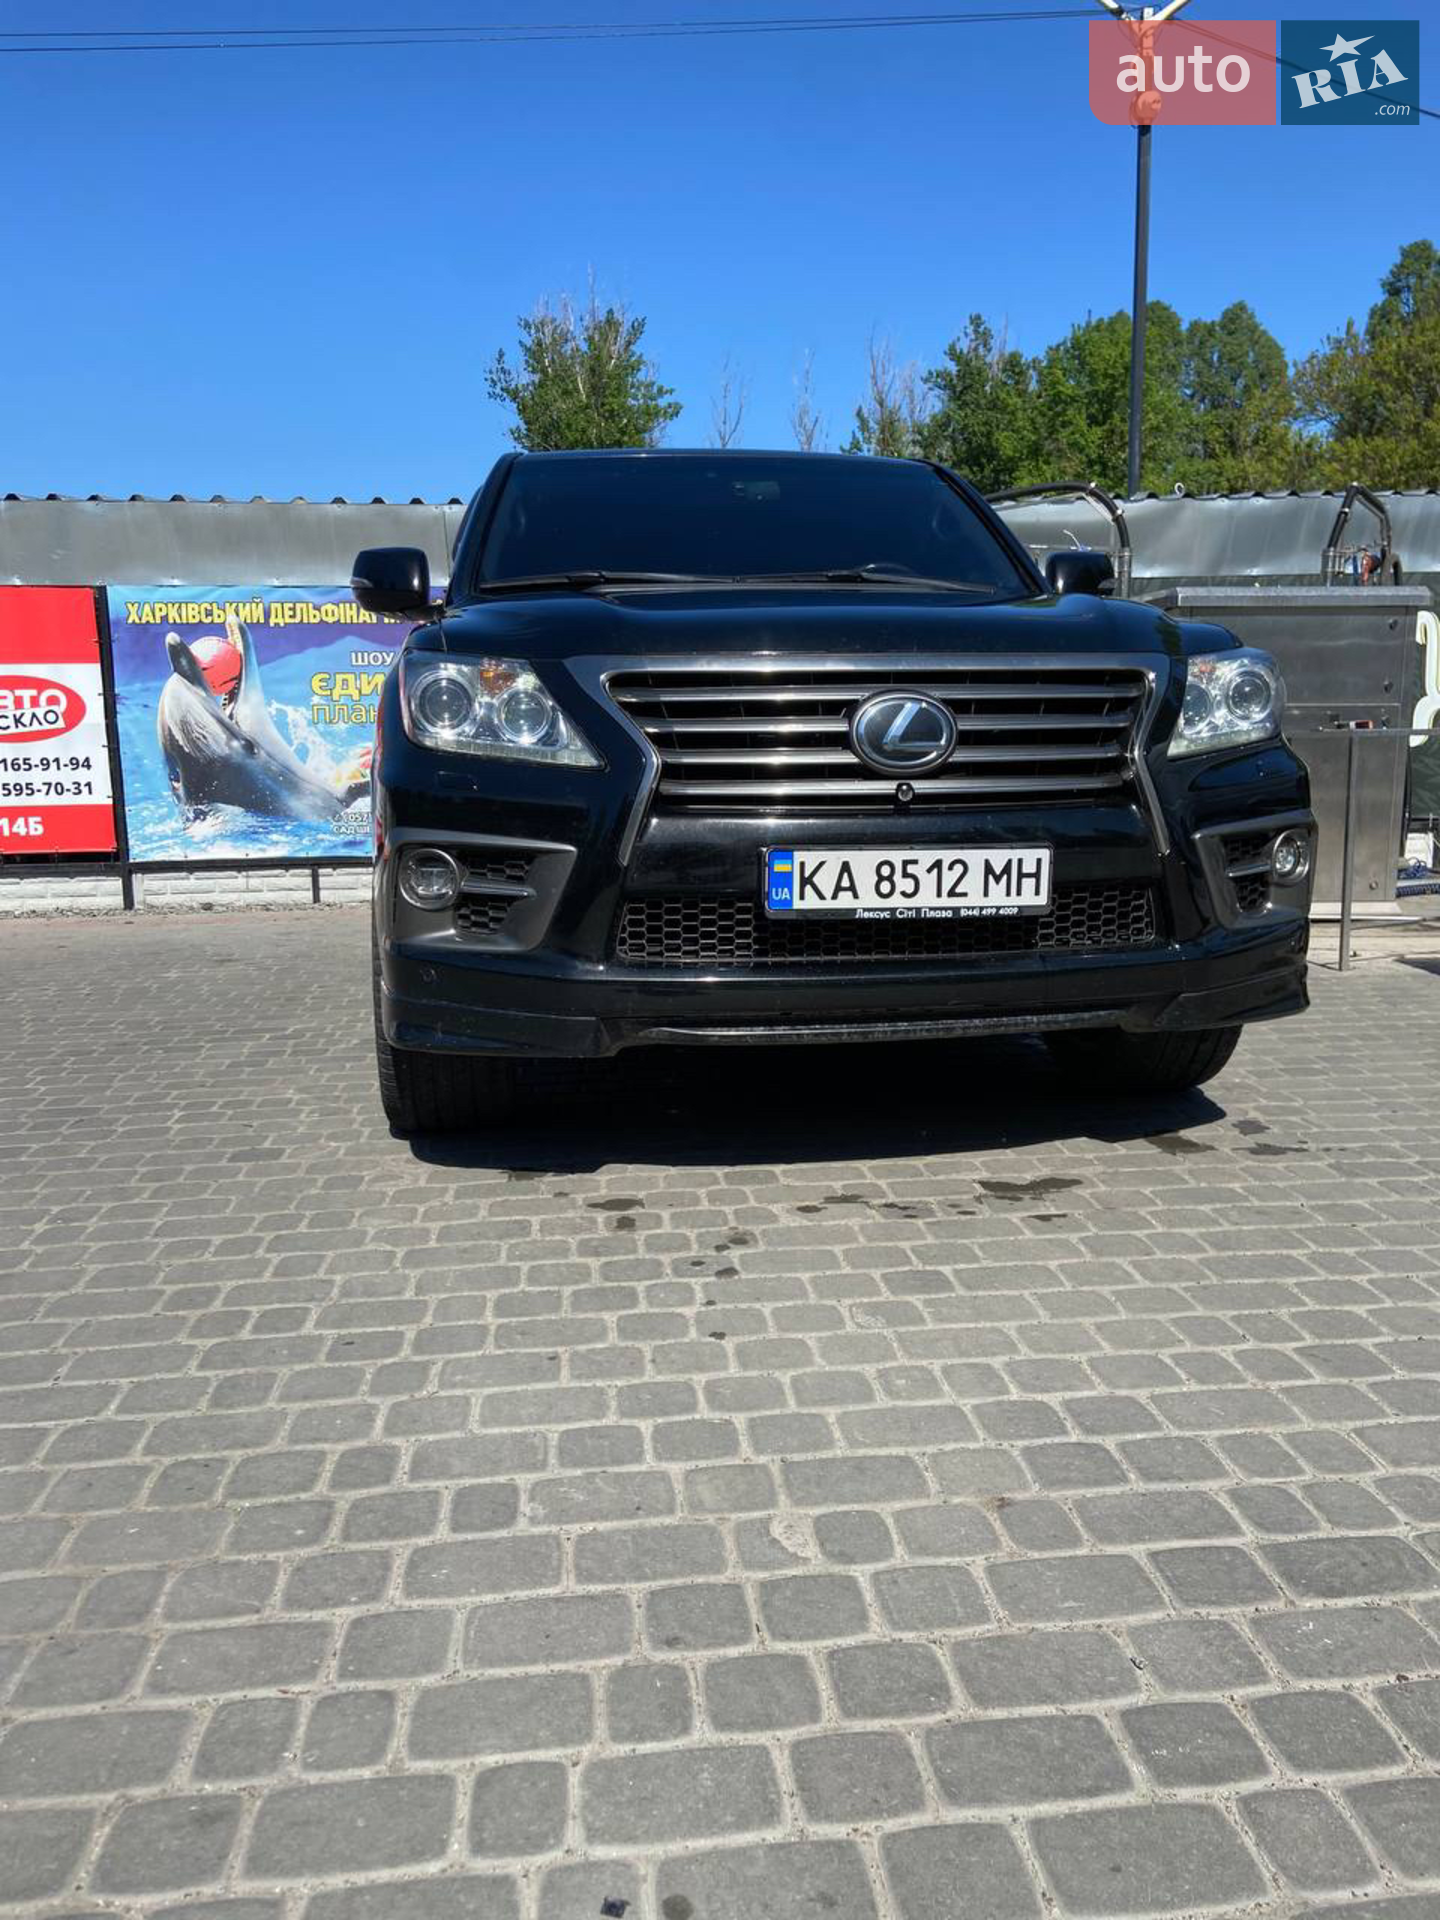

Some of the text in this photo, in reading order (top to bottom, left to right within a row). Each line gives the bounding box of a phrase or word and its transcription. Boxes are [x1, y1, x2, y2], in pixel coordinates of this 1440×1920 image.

[125, 598, 265, 625] ХАРКІВСЬКИЙ
[1, 781, 93, 797] 595-70-31
[798, 857, 1042, 901] KA 8512 MH
[771, 887, 791, 900] UA
[855, 908, 891, 919] Лексус
[921, 908, 953, 918] Плаза
[981, 907, 997, 916] 499
[998, 906, 1019, 915] 4009
